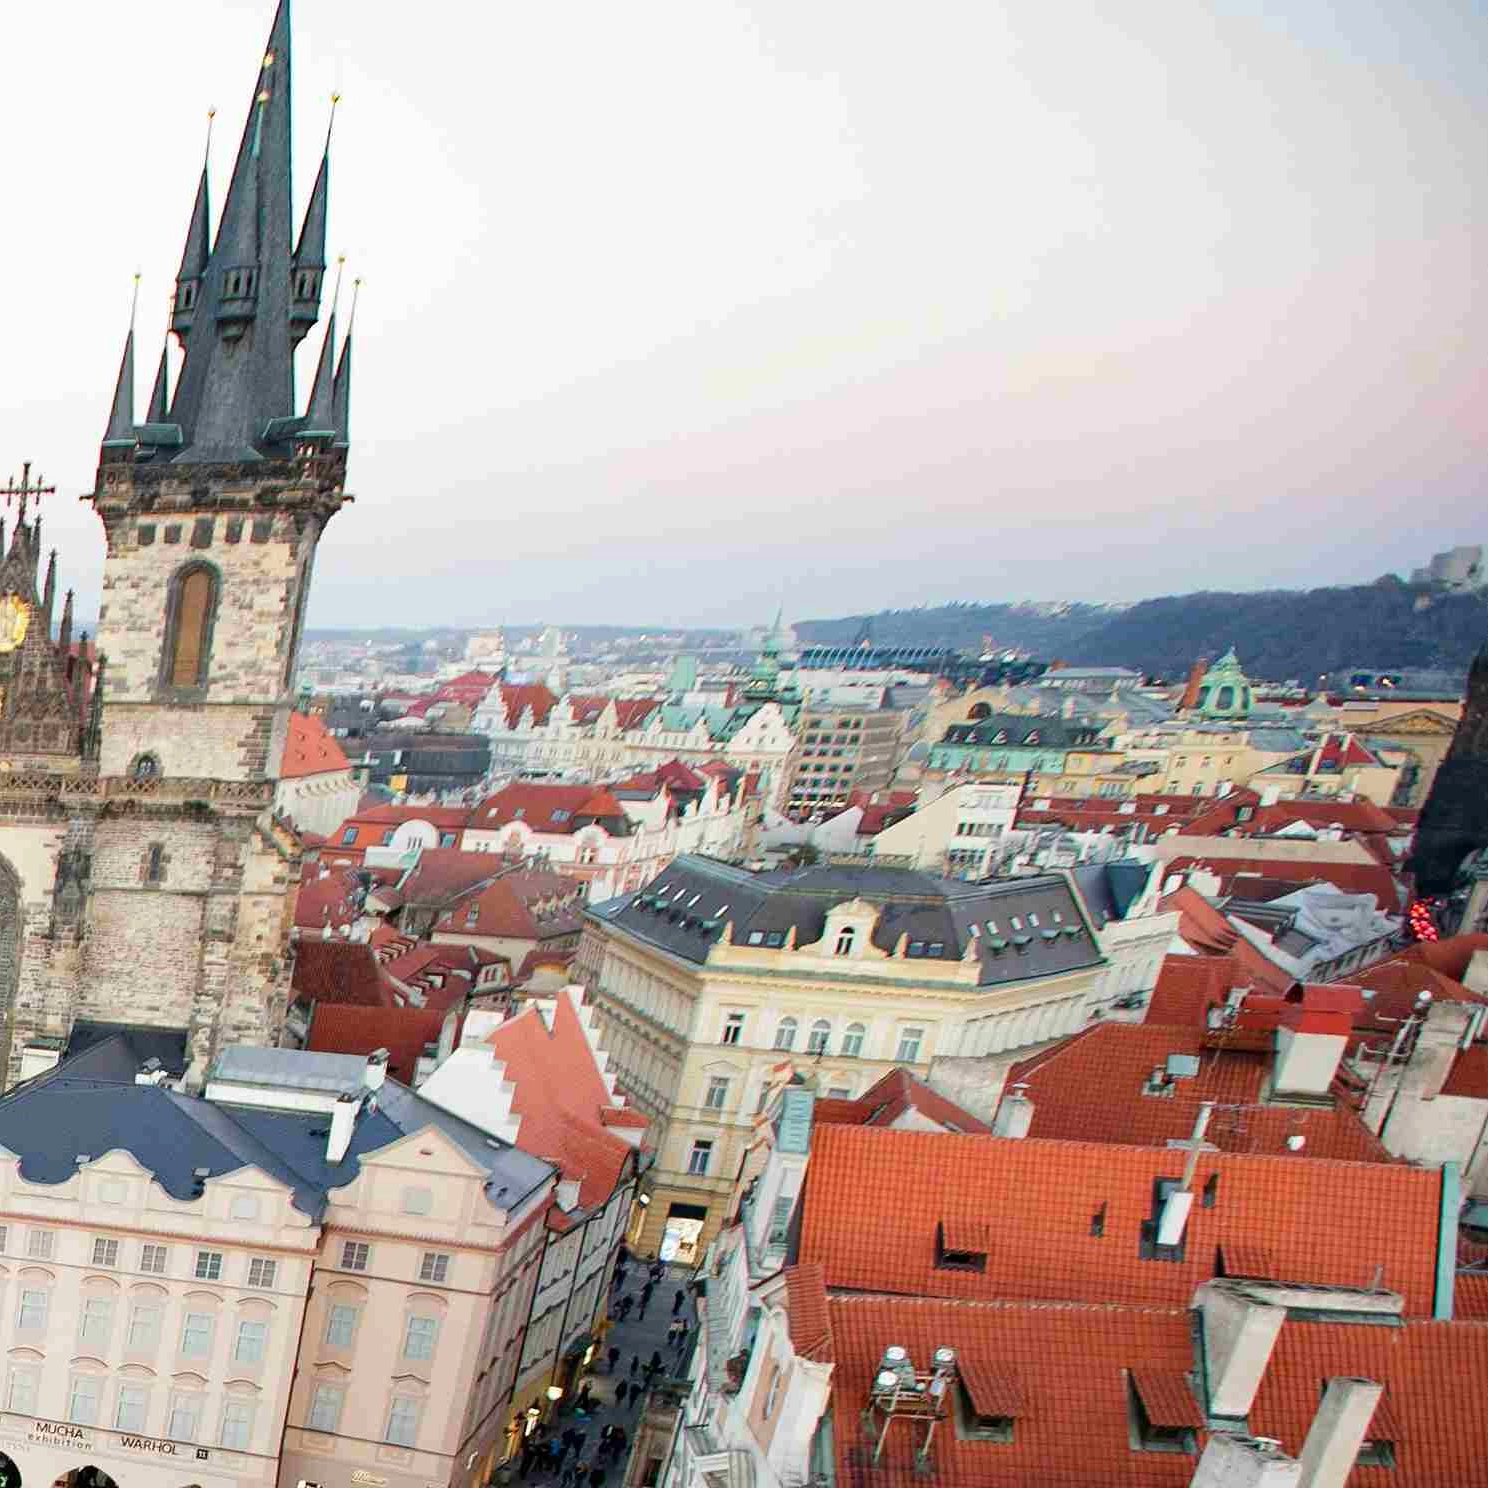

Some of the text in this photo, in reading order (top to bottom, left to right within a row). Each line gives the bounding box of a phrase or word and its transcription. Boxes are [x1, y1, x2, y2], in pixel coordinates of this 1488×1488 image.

[35, 1422, 84, 1440] MUCHA
[27, 1433, 92, 1451] exhibition
[120, 1436, 178, 1455] WARHOL
